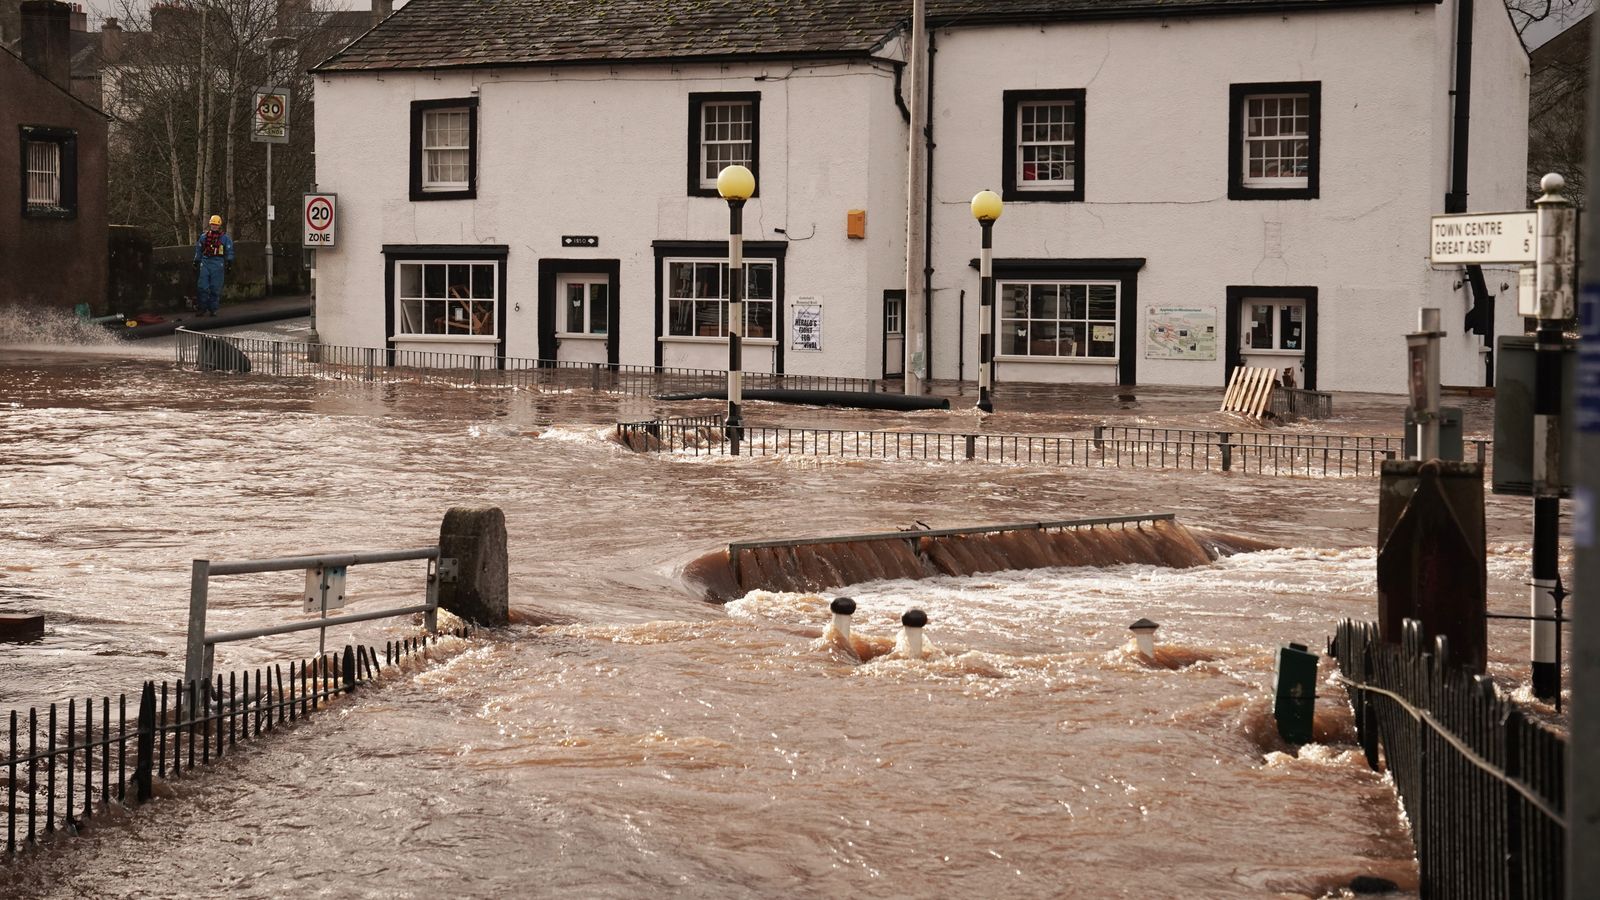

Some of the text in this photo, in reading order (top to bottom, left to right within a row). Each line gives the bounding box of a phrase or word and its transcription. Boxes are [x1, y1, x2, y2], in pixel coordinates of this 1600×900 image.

[262, 103, 280, 114] 30
[311, 206, 329, 220] 20
[1435, 223, 1462, 238] TOWN
[1464, 221, 1503, 236] CENTRE
[308, 233, 331, 242] ZONE
[1435, 238, 1530, 255] GREAT ASBY 5
